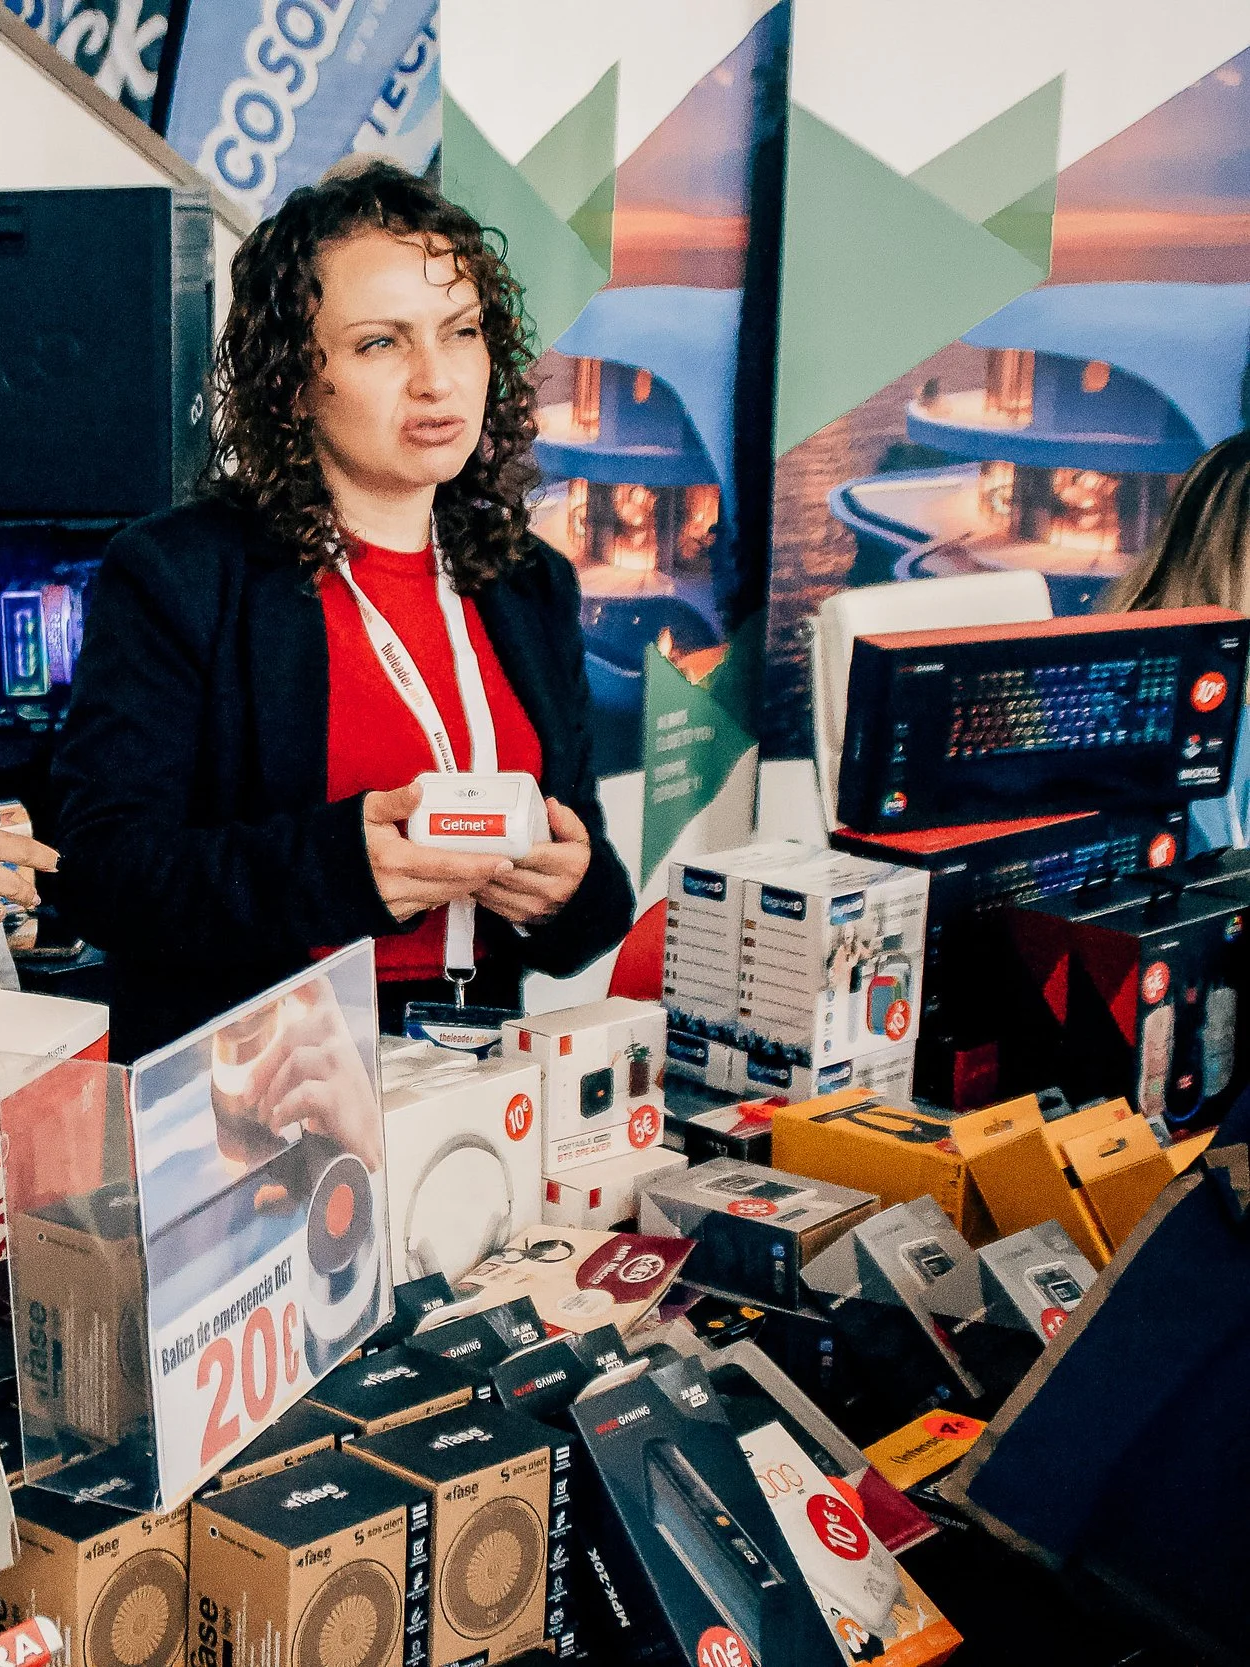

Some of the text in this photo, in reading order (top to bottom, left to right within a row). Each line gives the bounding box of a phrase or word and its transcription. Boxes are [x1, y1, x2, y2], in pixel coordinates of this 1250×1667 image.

[440, 818, 486, 832] Getnet
[508, 1097, 529, 1134] 10€
[632, 1112, 655, 1144] 5€
[162, 1255, 294, 1377] Baliza de emergencia DGT
[450, 1340, 481, 1358] GAMING
[196, 1301, 301, 1471] 20€
[535, 1370, 567, 1389] GAMING
[618, 1405, 650, 1425] GAMING
[452, 1483, 479, 1500] fase
[528, 1456, 548, 1470] alert
[91, 1538, 120, 1558] fase
[304, 1546, 332, 1566] fase
[384, 1516, 403, 1530] alert
[587, 1547, 630, 1628] MPK-20K
